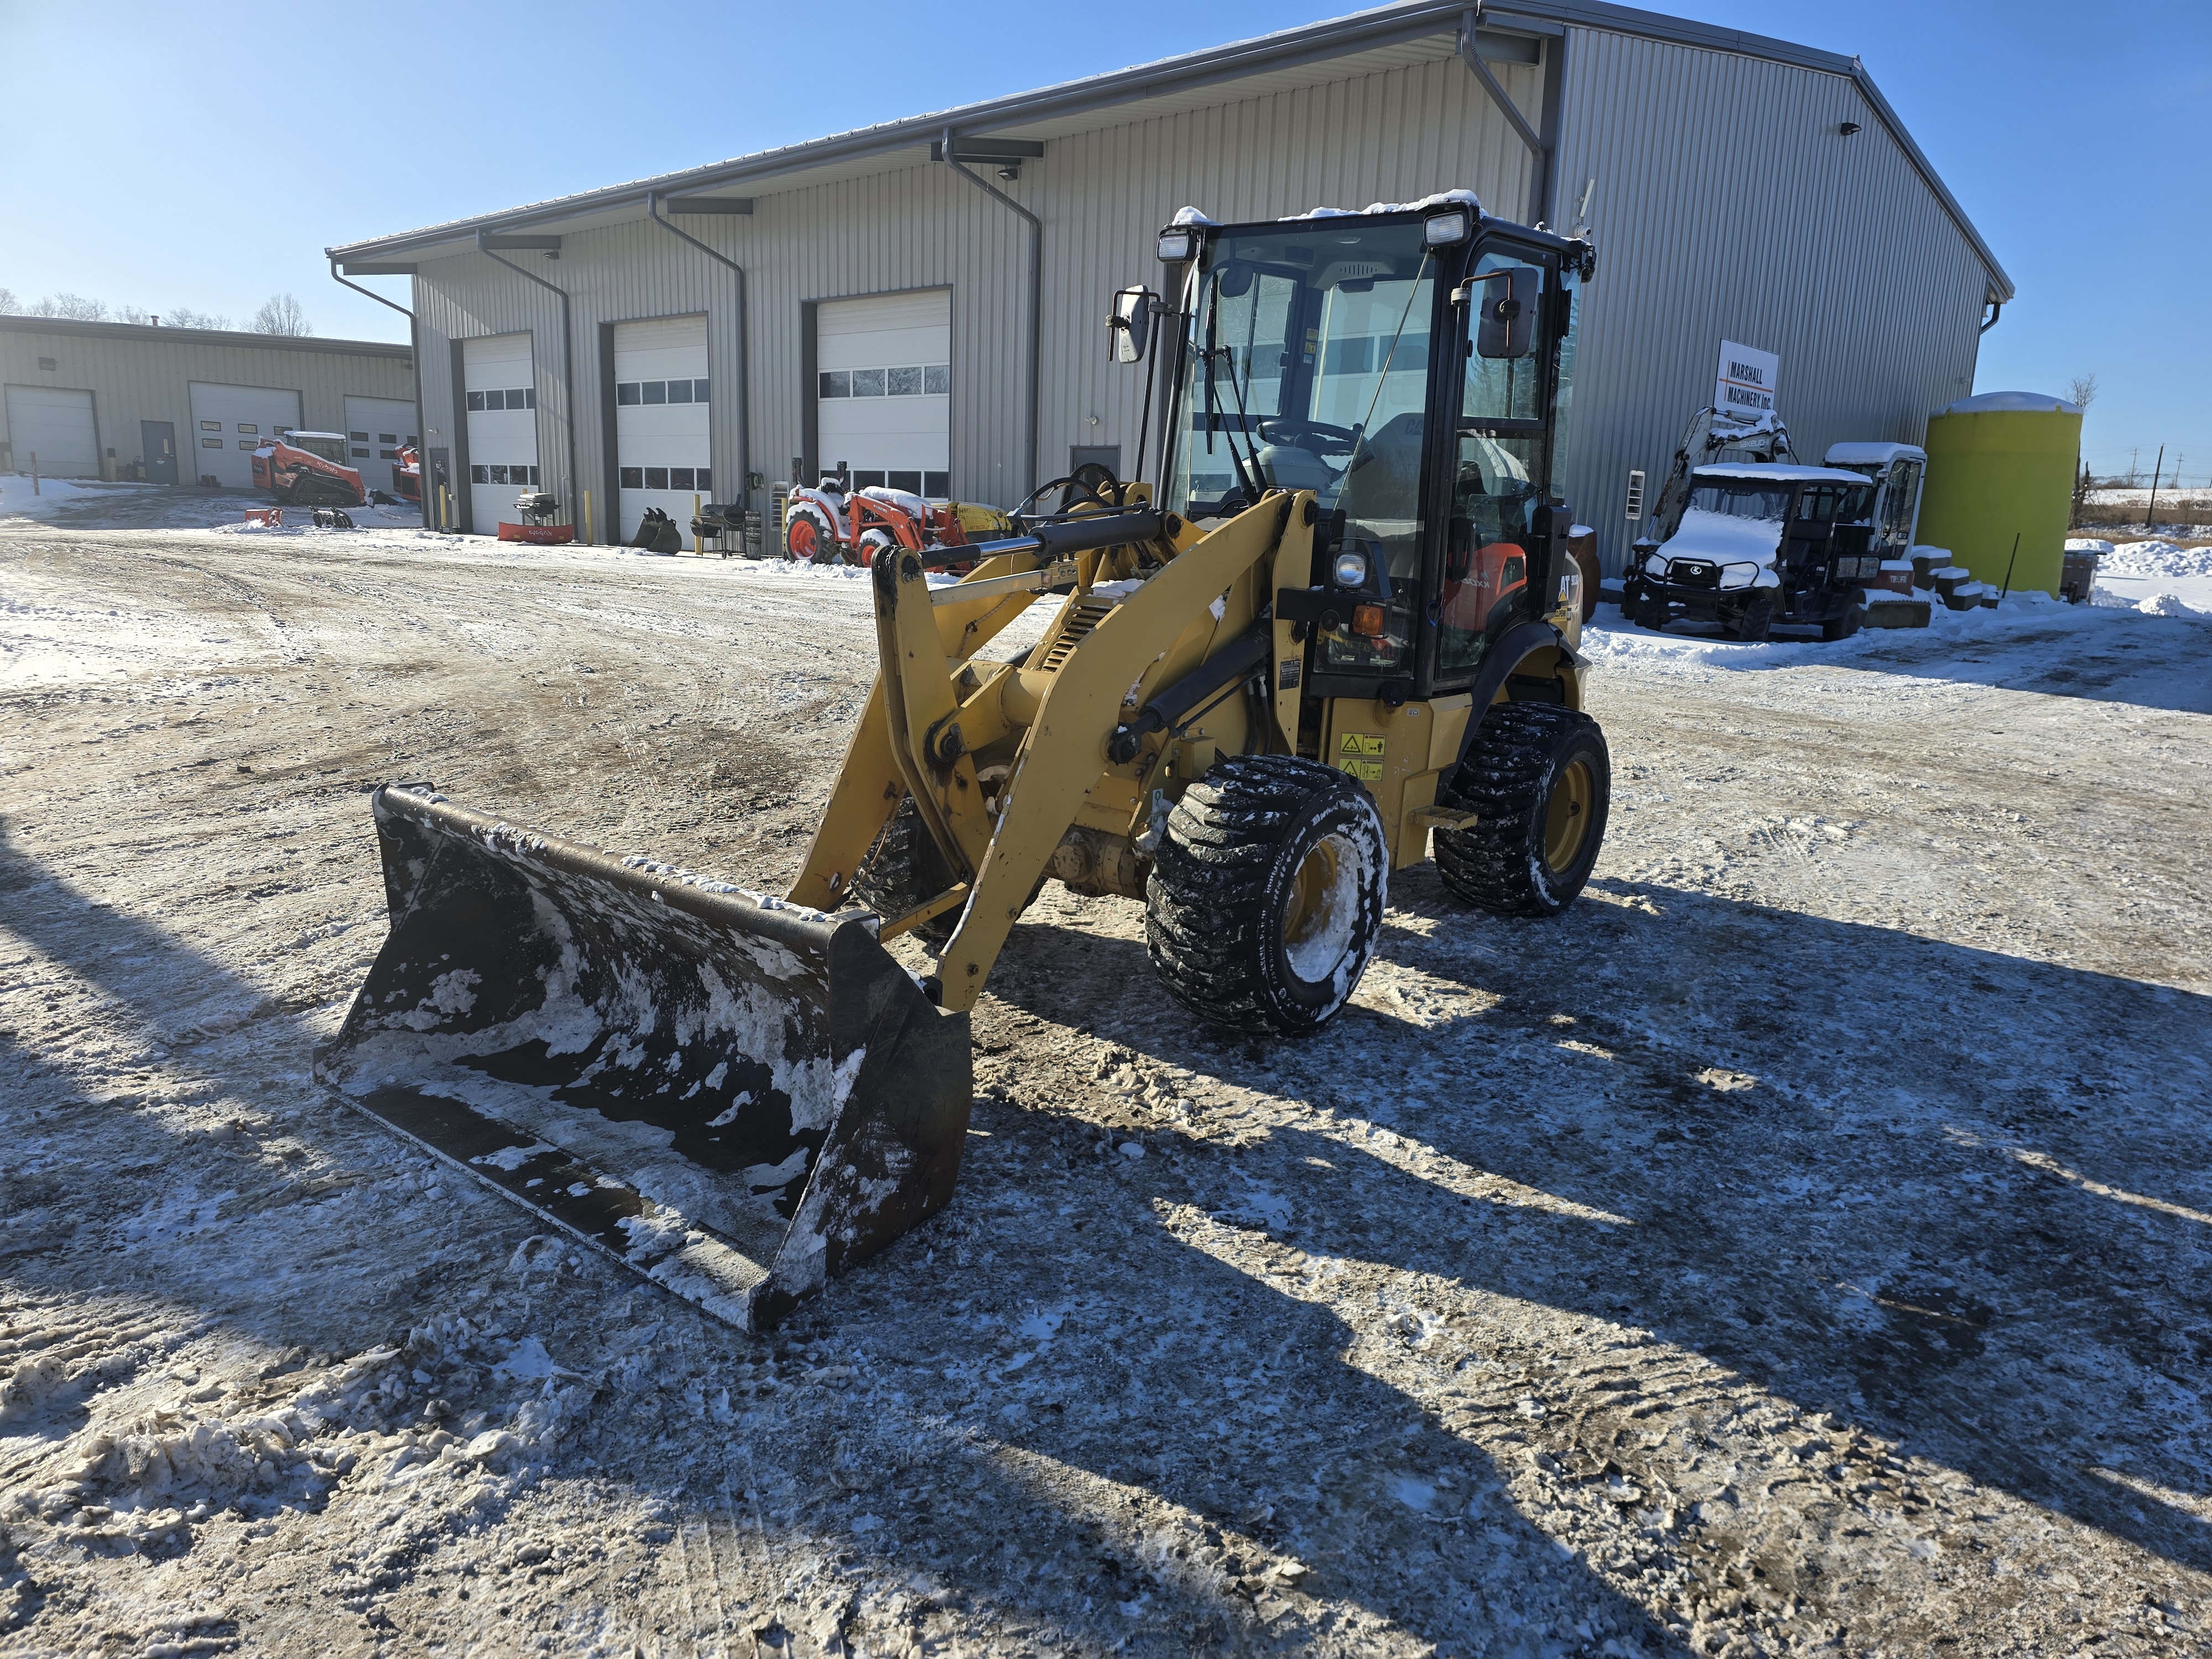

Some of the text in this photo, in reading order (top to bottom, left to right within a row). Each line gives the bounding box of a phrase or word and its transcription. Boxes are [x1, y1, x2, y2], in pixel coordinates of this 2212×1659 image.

[1730, 361, 1762, 384] MARSHALL
[1761, 394, 1771, 410] Inc.
[317, 461, 338, 474] Kubota
[1558, 575, 1570, 602] AT
